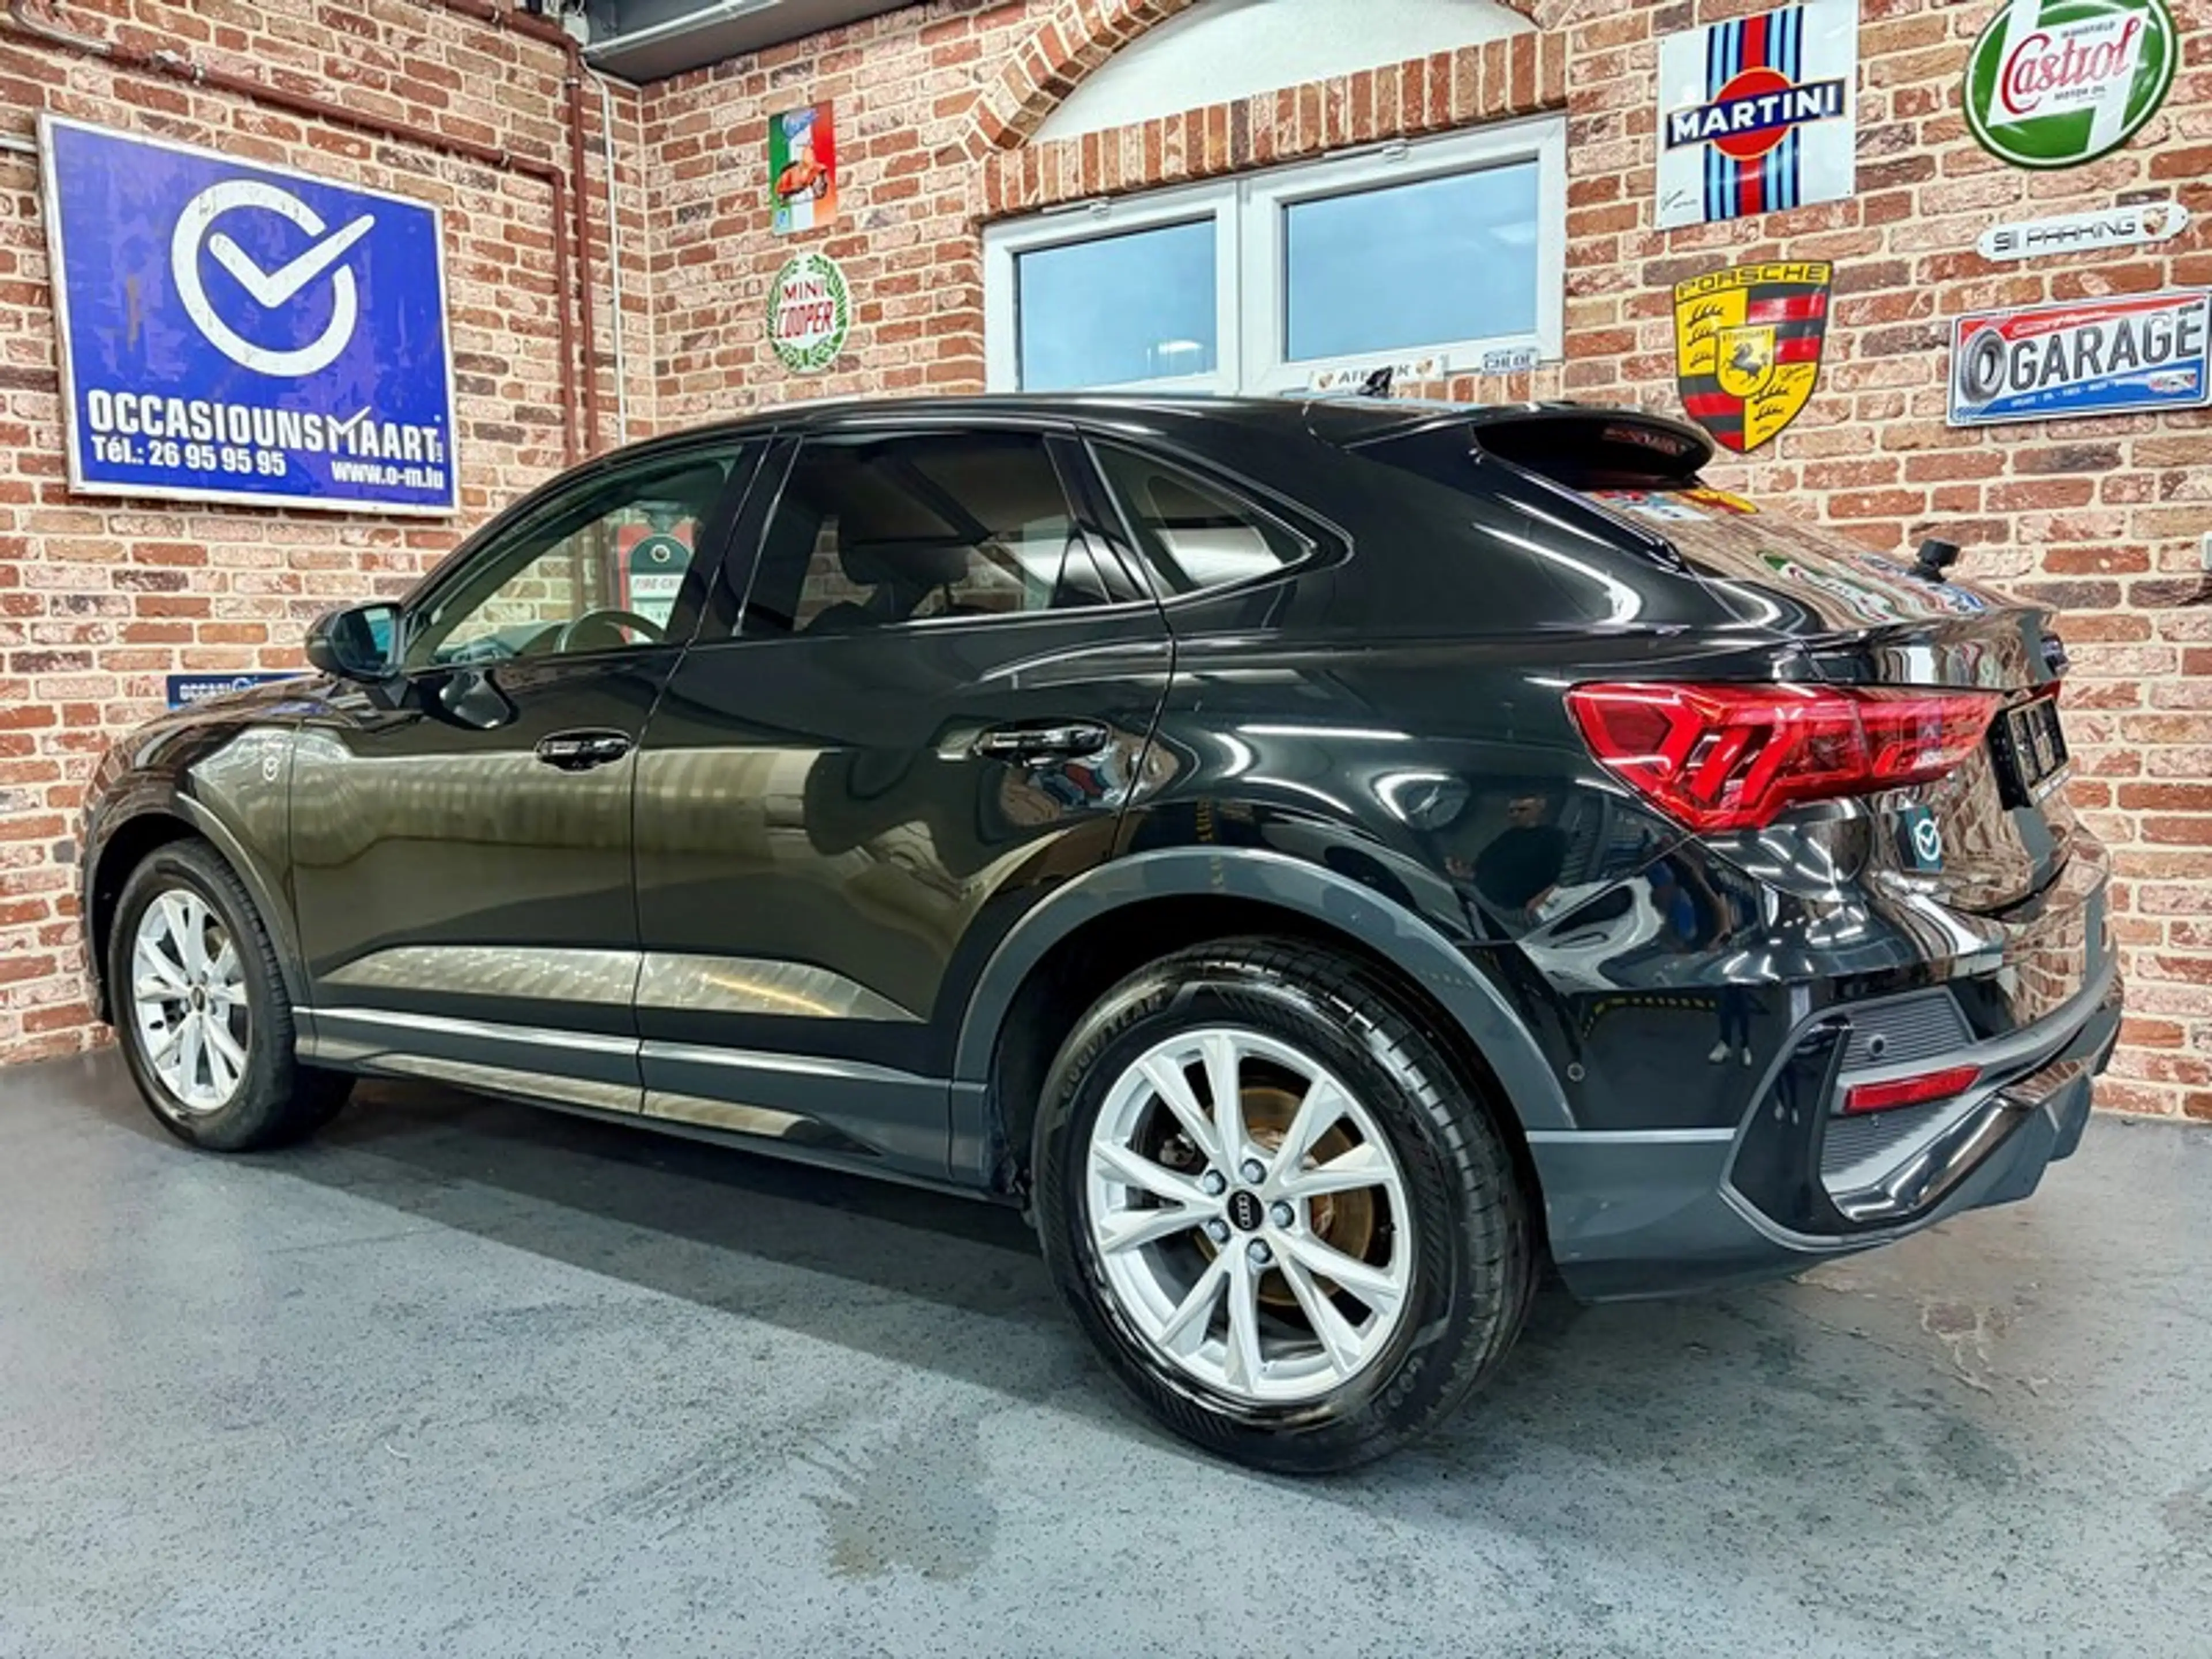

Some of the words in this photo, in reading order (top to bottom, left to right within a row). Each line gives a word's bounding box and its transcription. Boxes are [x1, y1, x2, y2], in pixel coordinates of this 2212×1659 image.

[2001, 16, 2141, 114] Castrol
[1674, 85, 1836, 142] MARTINI
[2027, 215, 2136, 247] PARKING
[783, 279, 825, 302] MINI
[1677, 264, 1825, 299] PORSCHE
[777, 301, 834, 339] COOPER
[2010, 301, 2205, 391] GARAGE
[88, 388, 438, 464] OCCASIOUNSMAART
[90, 434, 145, 465] Tél.:
[148, 440, 180, 468] 26
[184, 442, 218, 471] 95
[221, 446, 252, 474] 95
[256, 449, 286, 477] 95
[331, 460, 445, 490] www.o-m.lu
